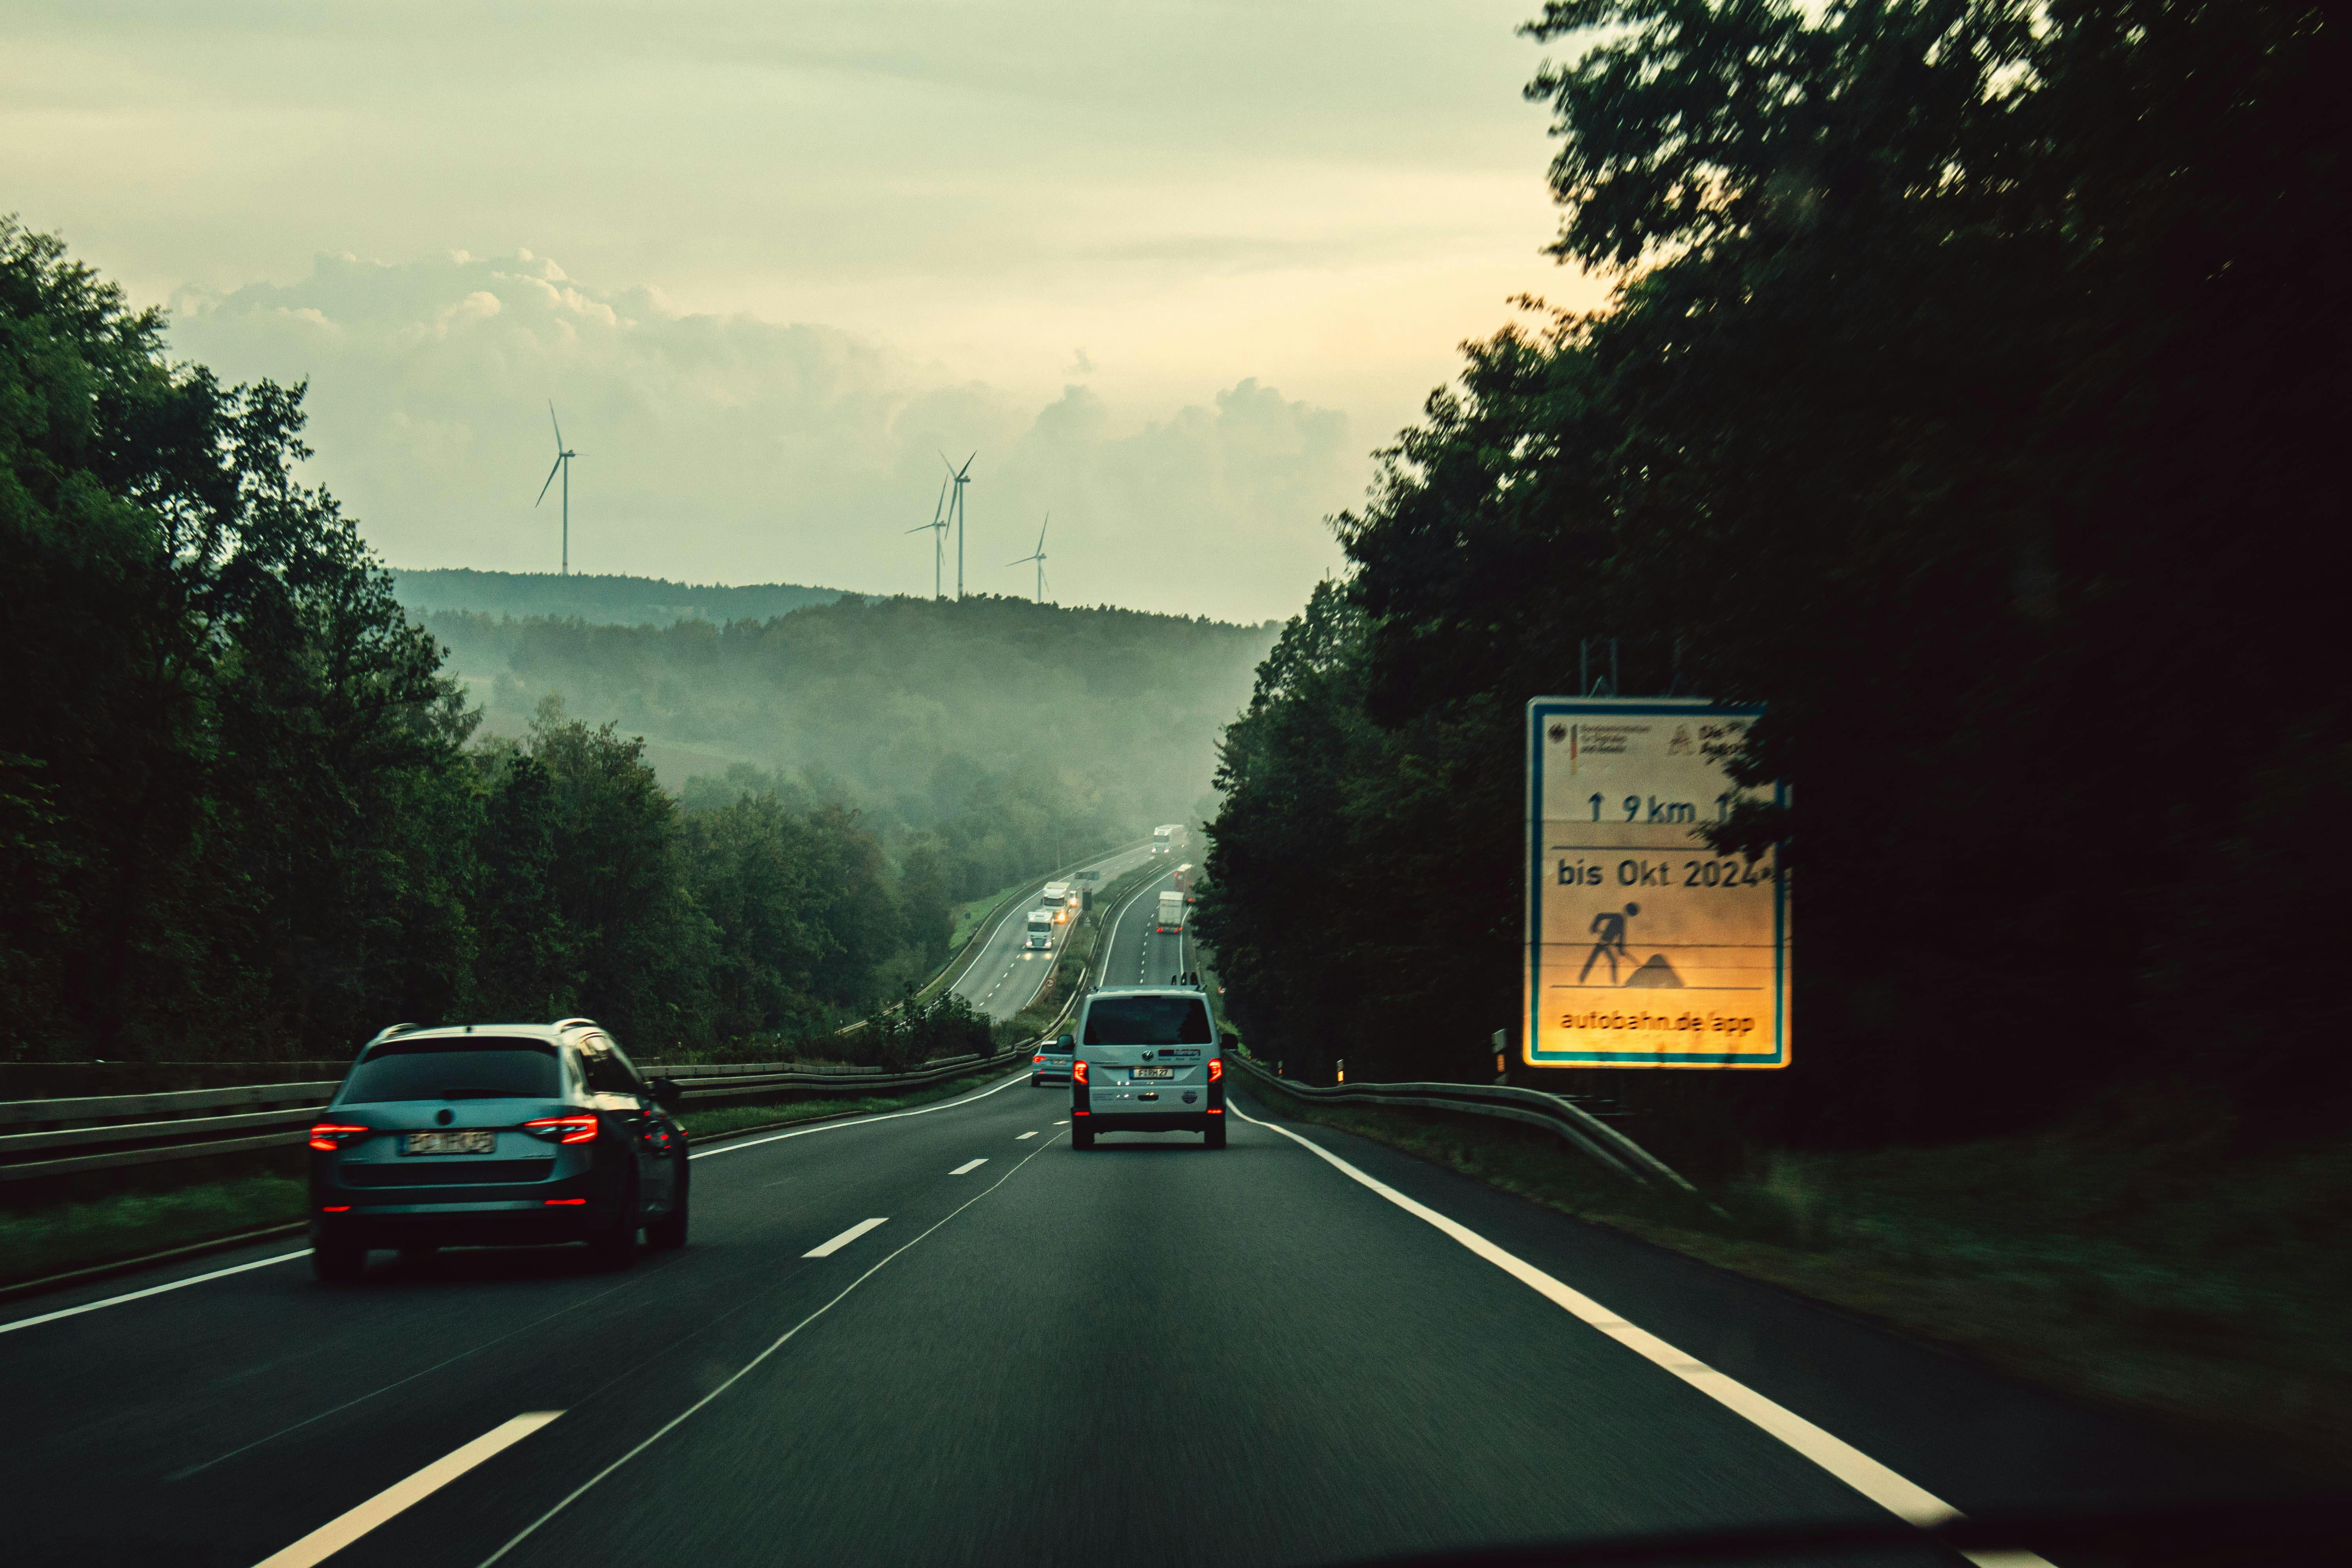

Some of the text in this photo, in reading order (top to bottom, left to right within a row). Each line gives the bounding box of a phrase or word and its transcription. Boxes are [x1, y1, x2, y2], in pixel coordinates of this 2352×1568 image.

[1622, 795, 1696, 823] 9 km
[1558, 858, 1759, 887] bis Okt 2024
[1561, 1011, 1755, 1037] autobahn.de/app
